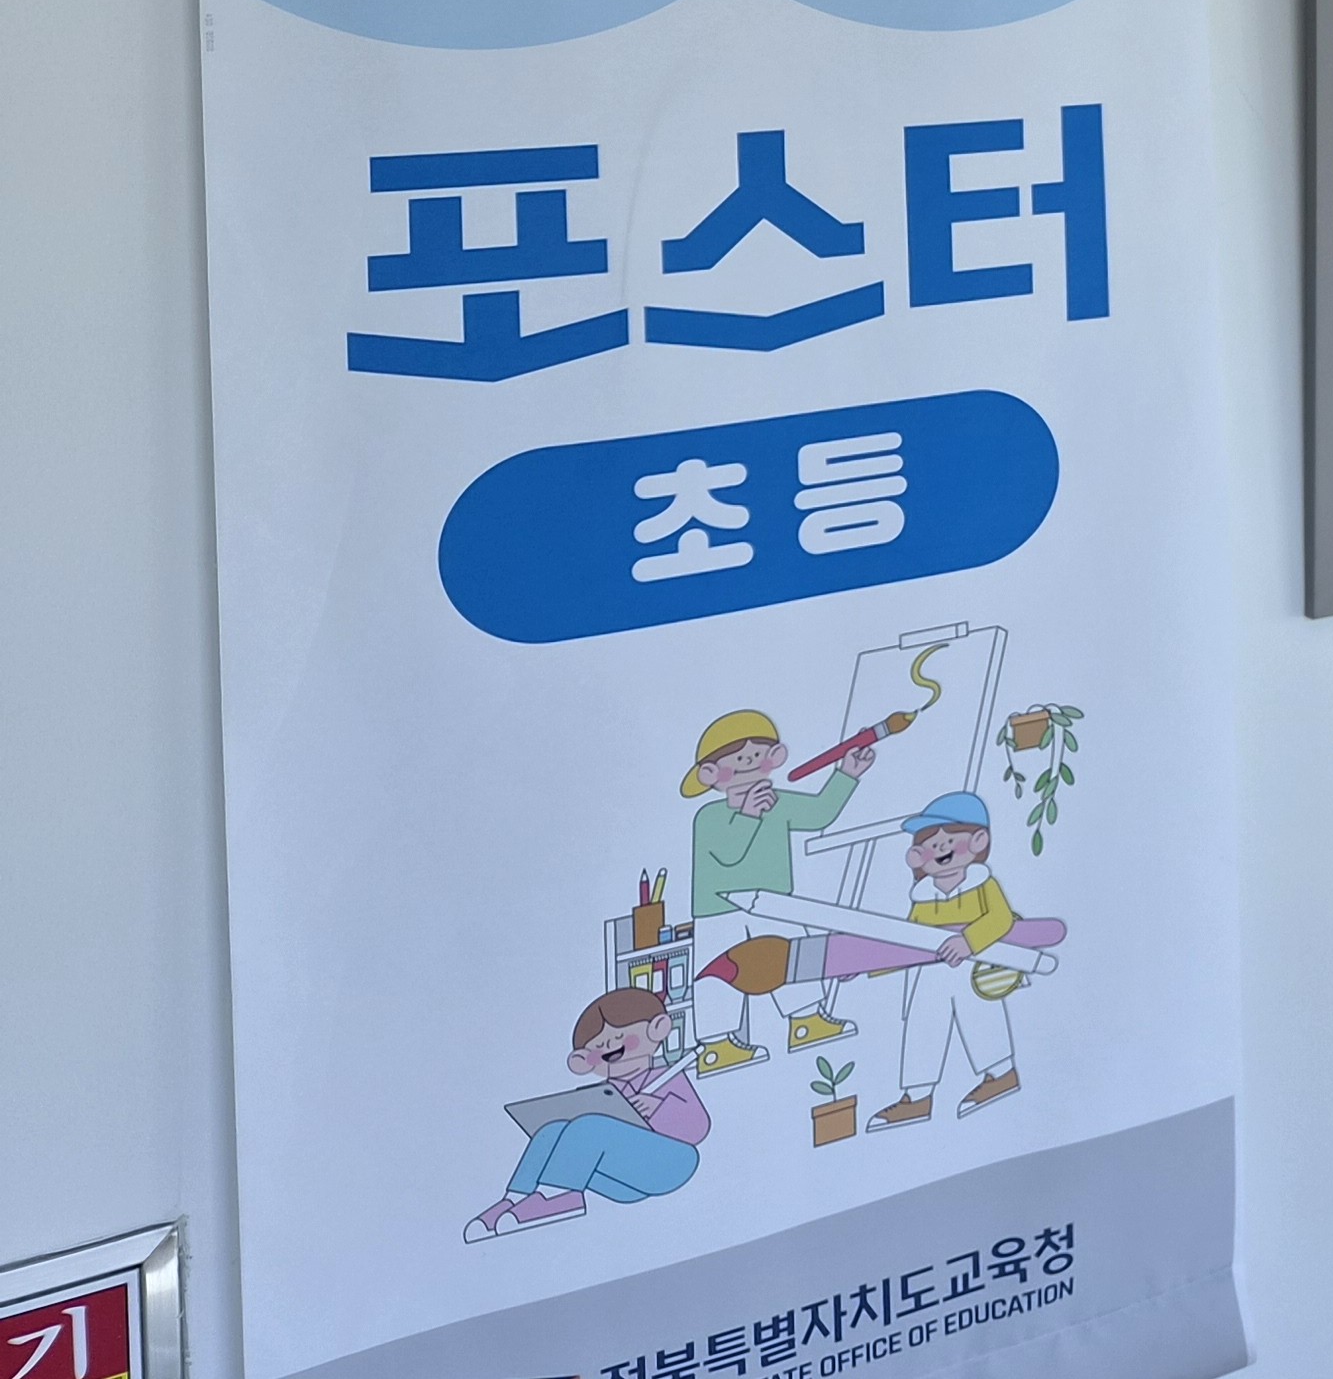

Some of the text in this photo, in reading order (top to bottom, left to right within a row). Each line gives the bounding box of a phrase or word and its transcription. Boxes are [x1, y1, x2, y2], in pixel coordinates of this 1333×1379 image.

[346, 103, 1111, 383] 포스터
[819, 1329, 903, 1379] OFFICE
[907, 1320, 938, 1352] OF
[943, 1276, 1076, 1336] EDUCATION
